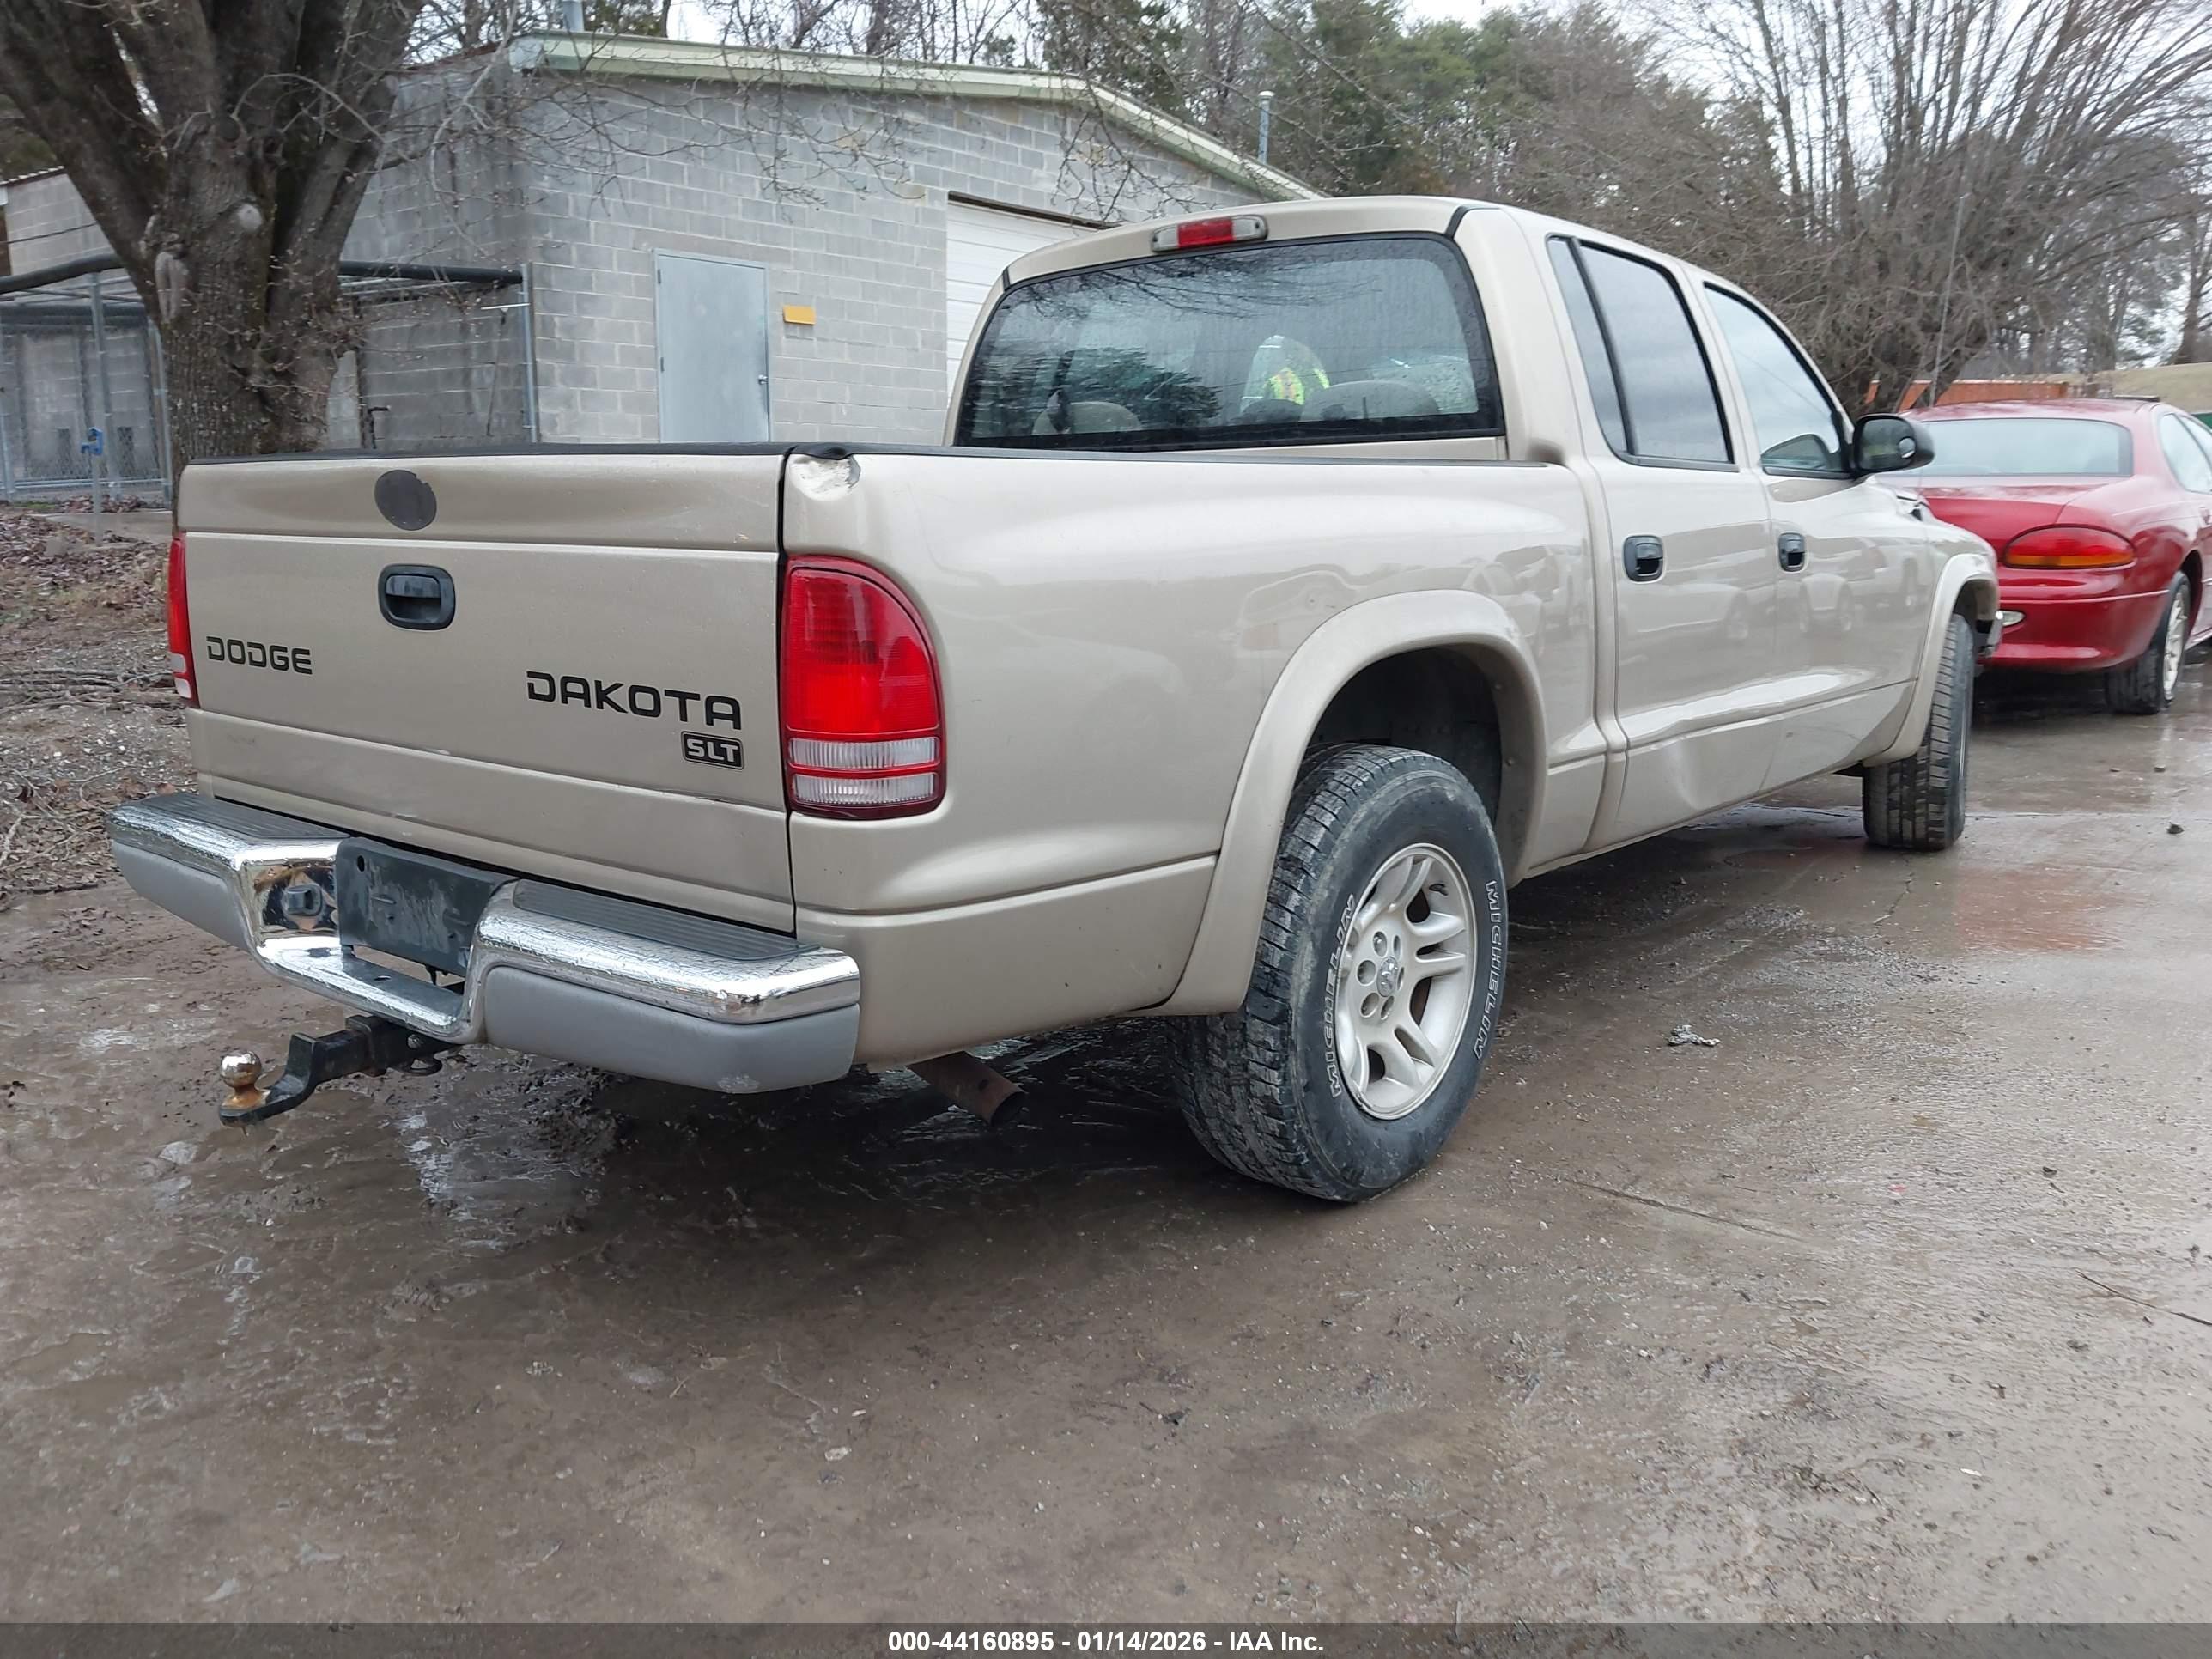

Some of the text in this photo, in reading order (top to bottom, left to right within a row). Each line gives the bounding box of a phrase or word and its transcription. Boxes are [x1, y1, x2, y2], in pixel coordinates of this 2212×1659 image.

[206, 635, 313, 676] DODGE
[526, 670, 743, 731] DAKOTA
[687, 738, 739, 763] SLT
[1323, 893, 1356, 1099] MICHELIN
[1473, 879, 1503, 1060] MICHELIN
